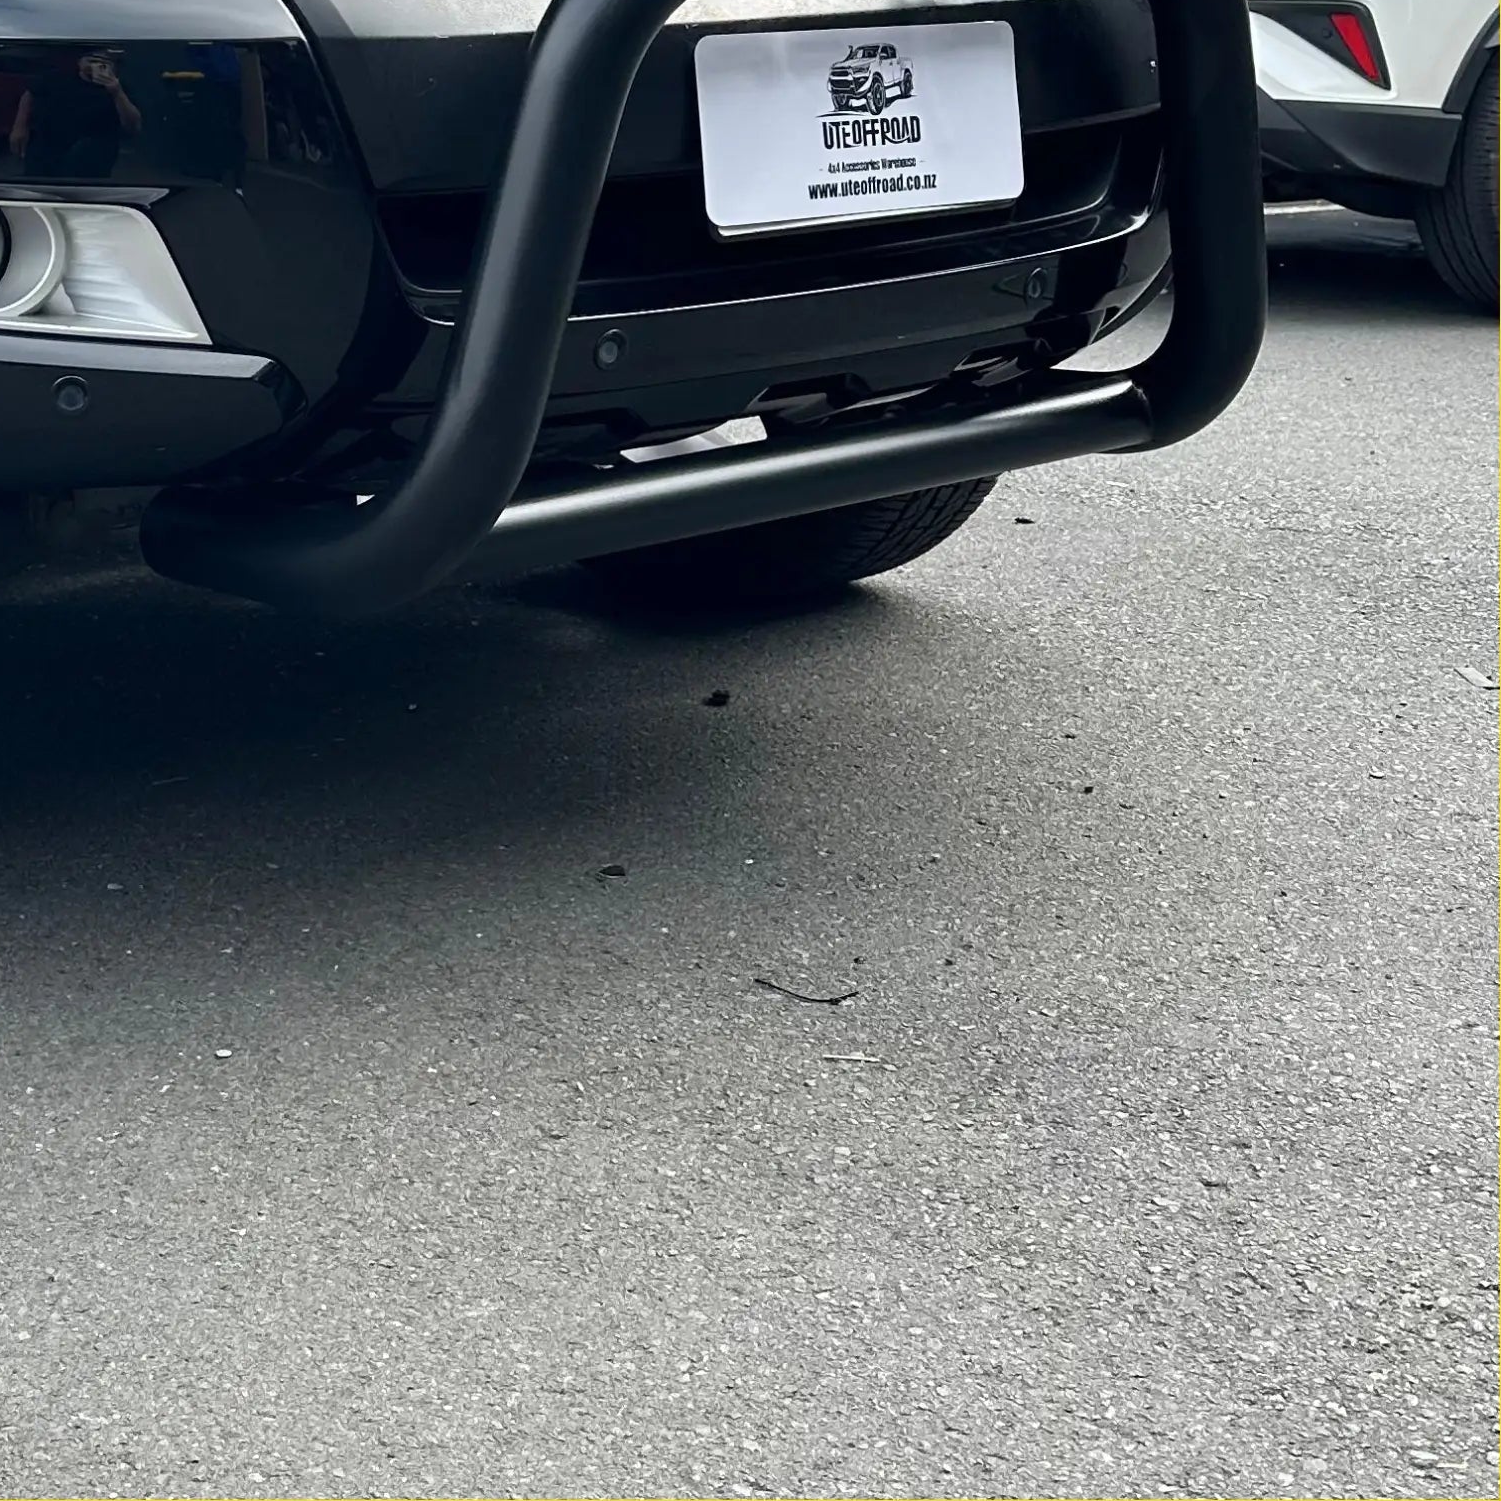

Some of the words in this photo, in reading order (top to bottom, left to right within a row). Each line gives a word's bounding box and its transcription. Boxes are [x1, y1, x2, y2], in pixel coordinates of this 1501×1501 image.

[822, 115, 922, 150] UTEOFFROAD
[841, 158, 880, 173] Accessories
[881, 157, 917, 170] Warehouse
[807, 173, 938, 200] www.uteoffroad.co.nz
